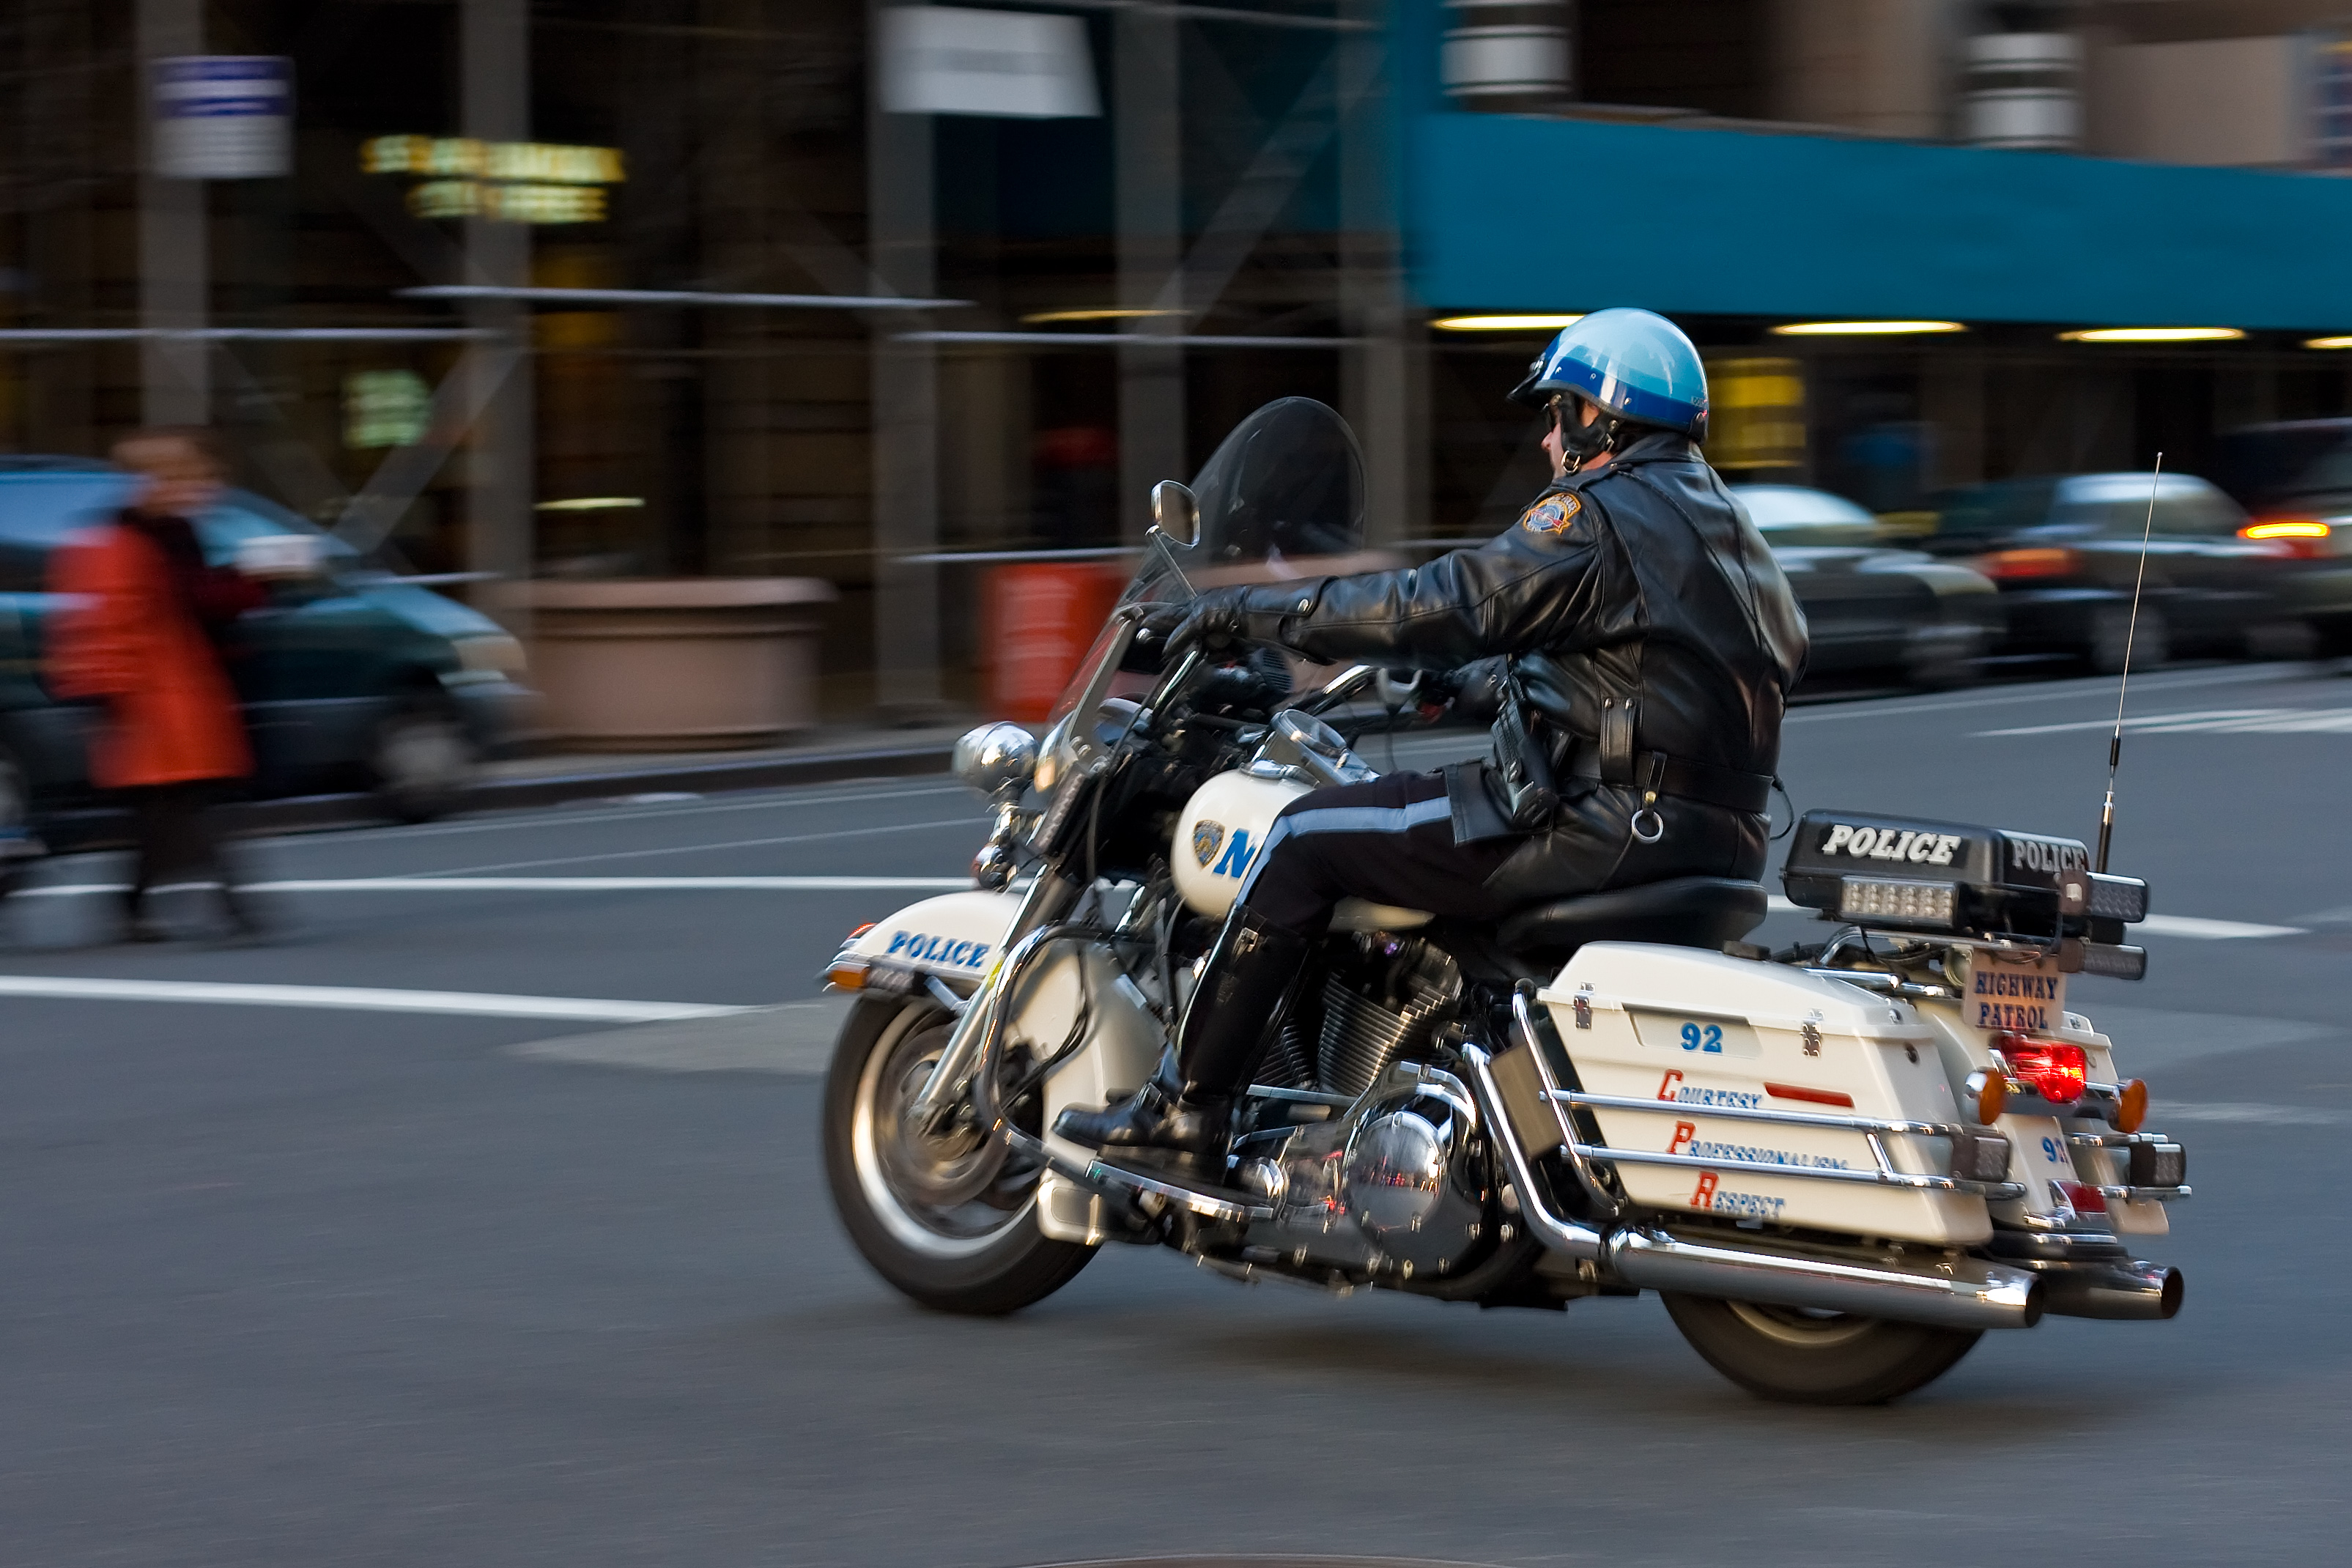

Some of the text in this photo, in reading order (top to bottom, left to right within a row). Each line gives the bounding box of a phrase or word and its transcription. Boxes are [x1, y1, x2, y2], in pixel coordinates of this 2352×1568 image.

[1822, 824, 1961, 866] POLICE
[2011, 839, 2085, 873] POLICE
[885, 931, 991, 969] POLICE
[1975, 971, 2057, 999] HIGHWAY
[1979, 1002, 2048, 1029] PATROL
[1681, 1022, 1723, 1054] 92
